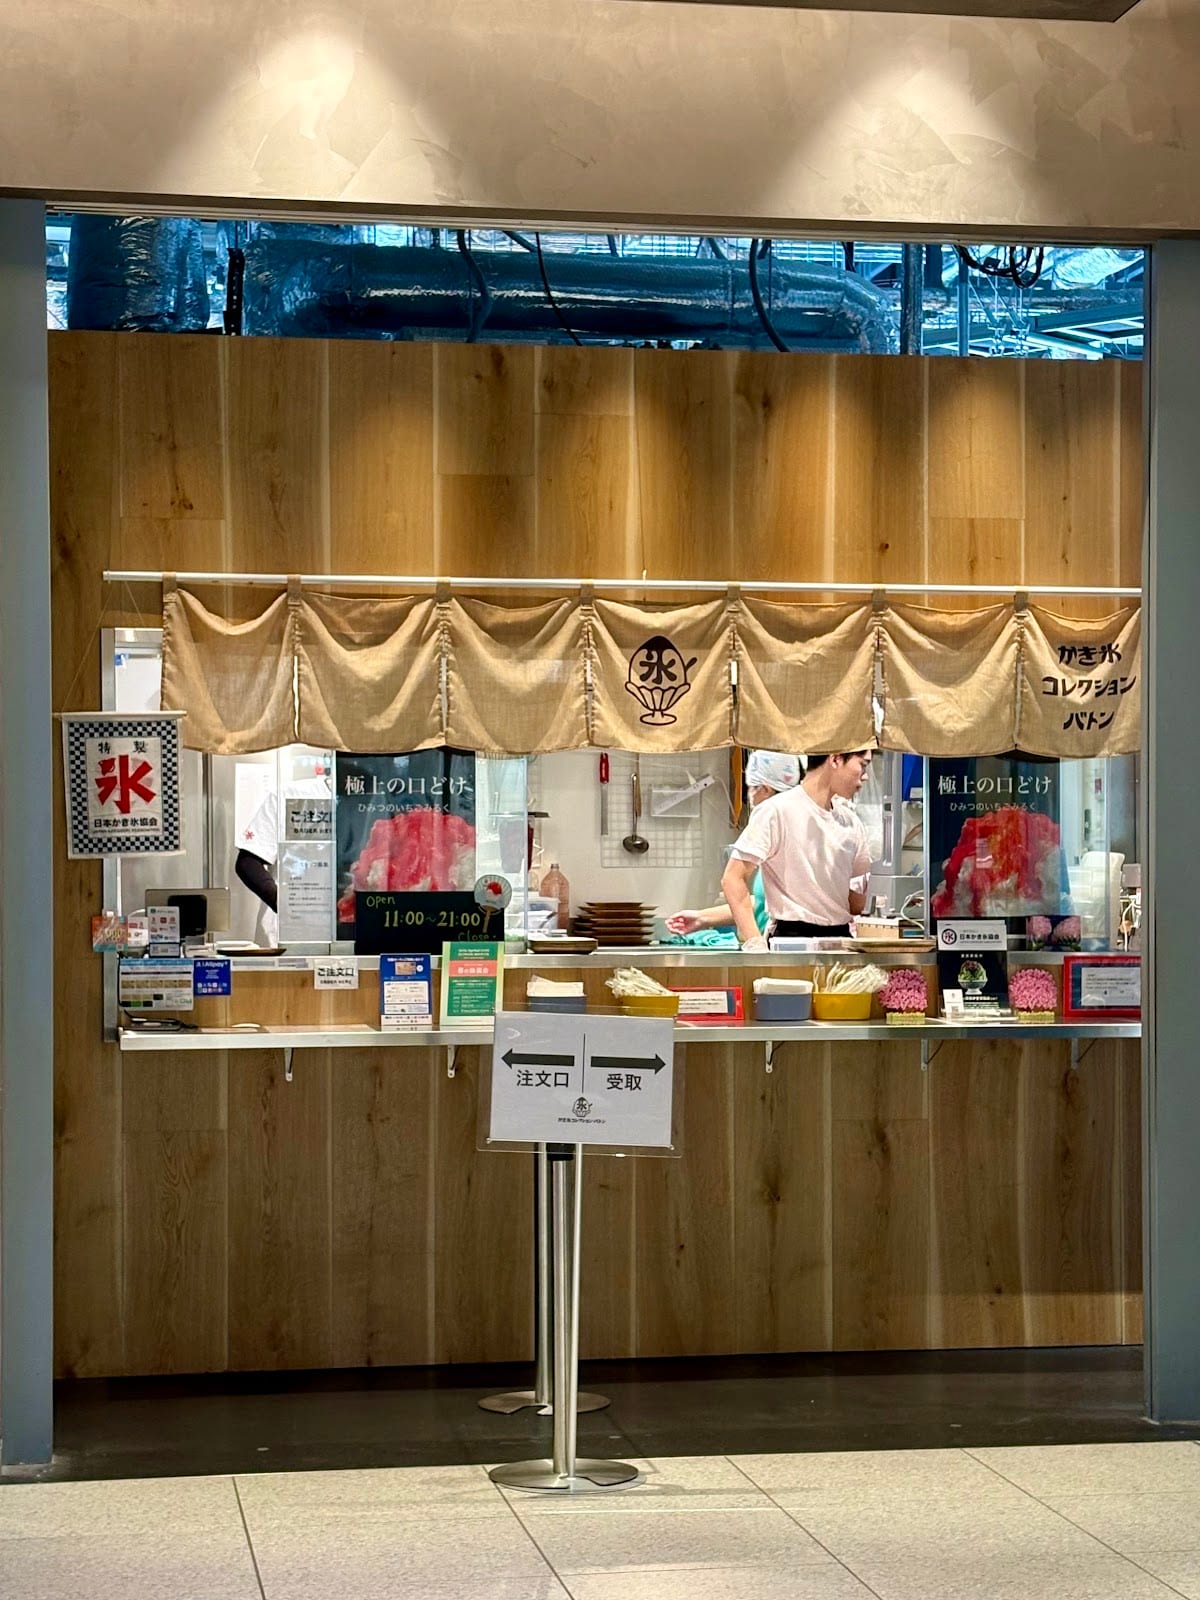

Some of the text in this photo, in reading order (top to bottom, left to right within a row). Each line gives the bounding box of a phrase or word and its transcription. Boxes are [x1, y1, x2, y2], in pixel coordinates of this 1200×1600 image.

[1057, 643, 1122, 666] かき氷
[639, 648, 677, 685] 氷
[1042, 676, 1137, 698] コレクション
[1062, 710, 1115, 731] バトン
[94, 754, 157, 814] 氷
[344, 775, 468, 796] 極上の口どけ
[937, 775, 1053, 796] 極上の口どけ
[291, 810, 332, 823] ご注文
[357, 803, 450, 814] ひみつのいちごみるく
[949, 802, 1037, 812] ひみつのいちごみるく
[93, 817, 158, 828] 日本かき氷協会
[317, 967, 355, 977] ご注文口
[516, 1069, 570, 1088] 注文口
[606, 1072, 643, 1091] 受取
